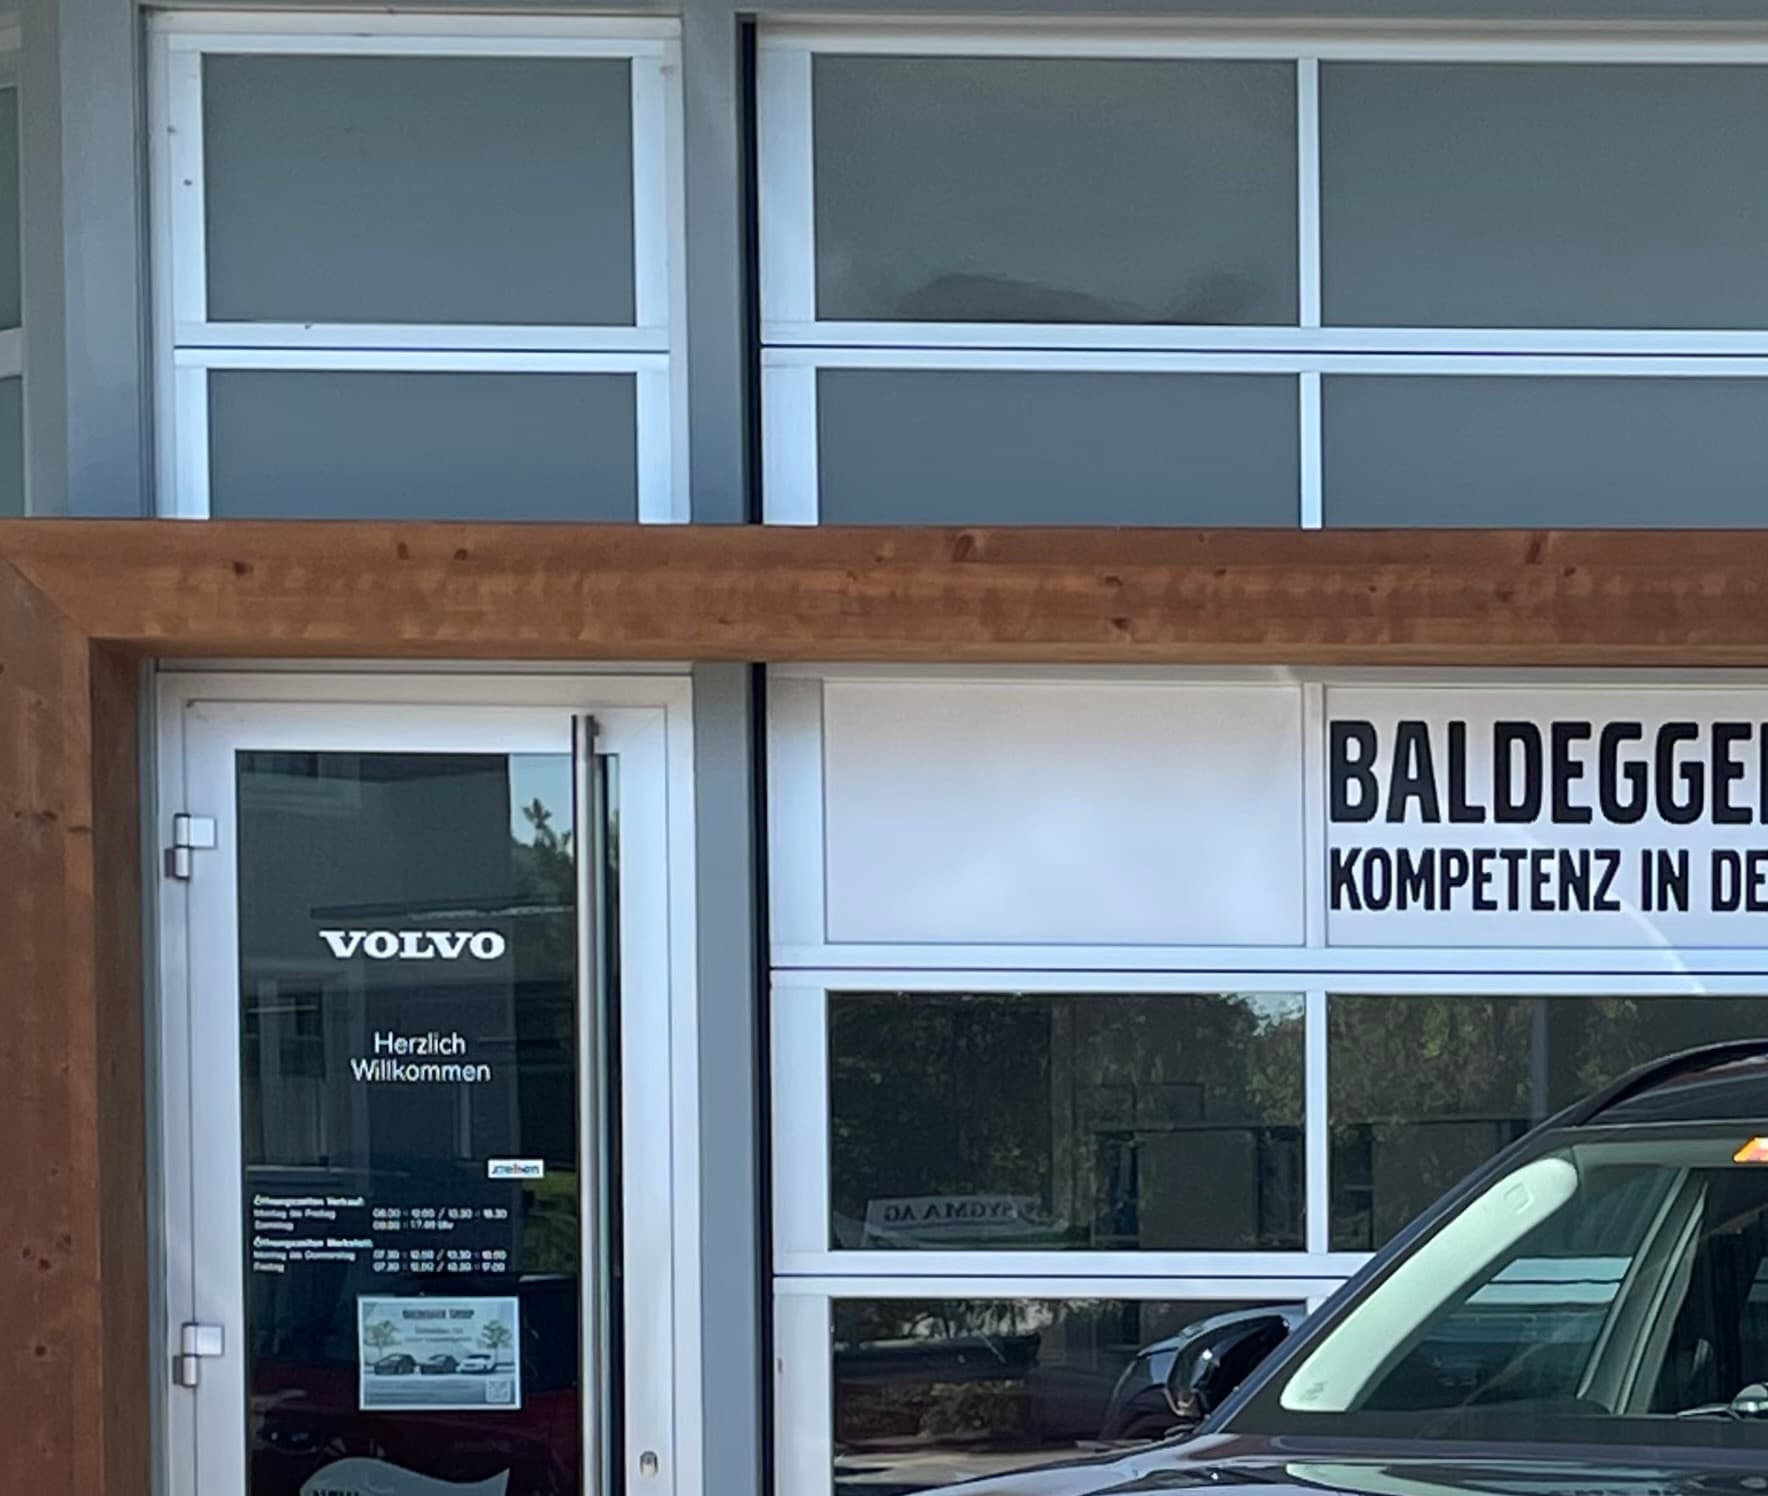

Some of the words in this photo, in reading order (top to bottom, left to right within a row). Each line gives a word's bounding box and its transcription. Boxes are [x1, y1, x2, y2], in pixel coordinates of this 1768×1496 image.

[1329, 847, 1623, 912] KOMPETENZ
[1641, 848, 1689, 912] IN
[319, 930, 505, 959] VOLVO
[374, 1032, 466, 1055] Herzlich
[350, 1059, 491, 1082] Willkommen
